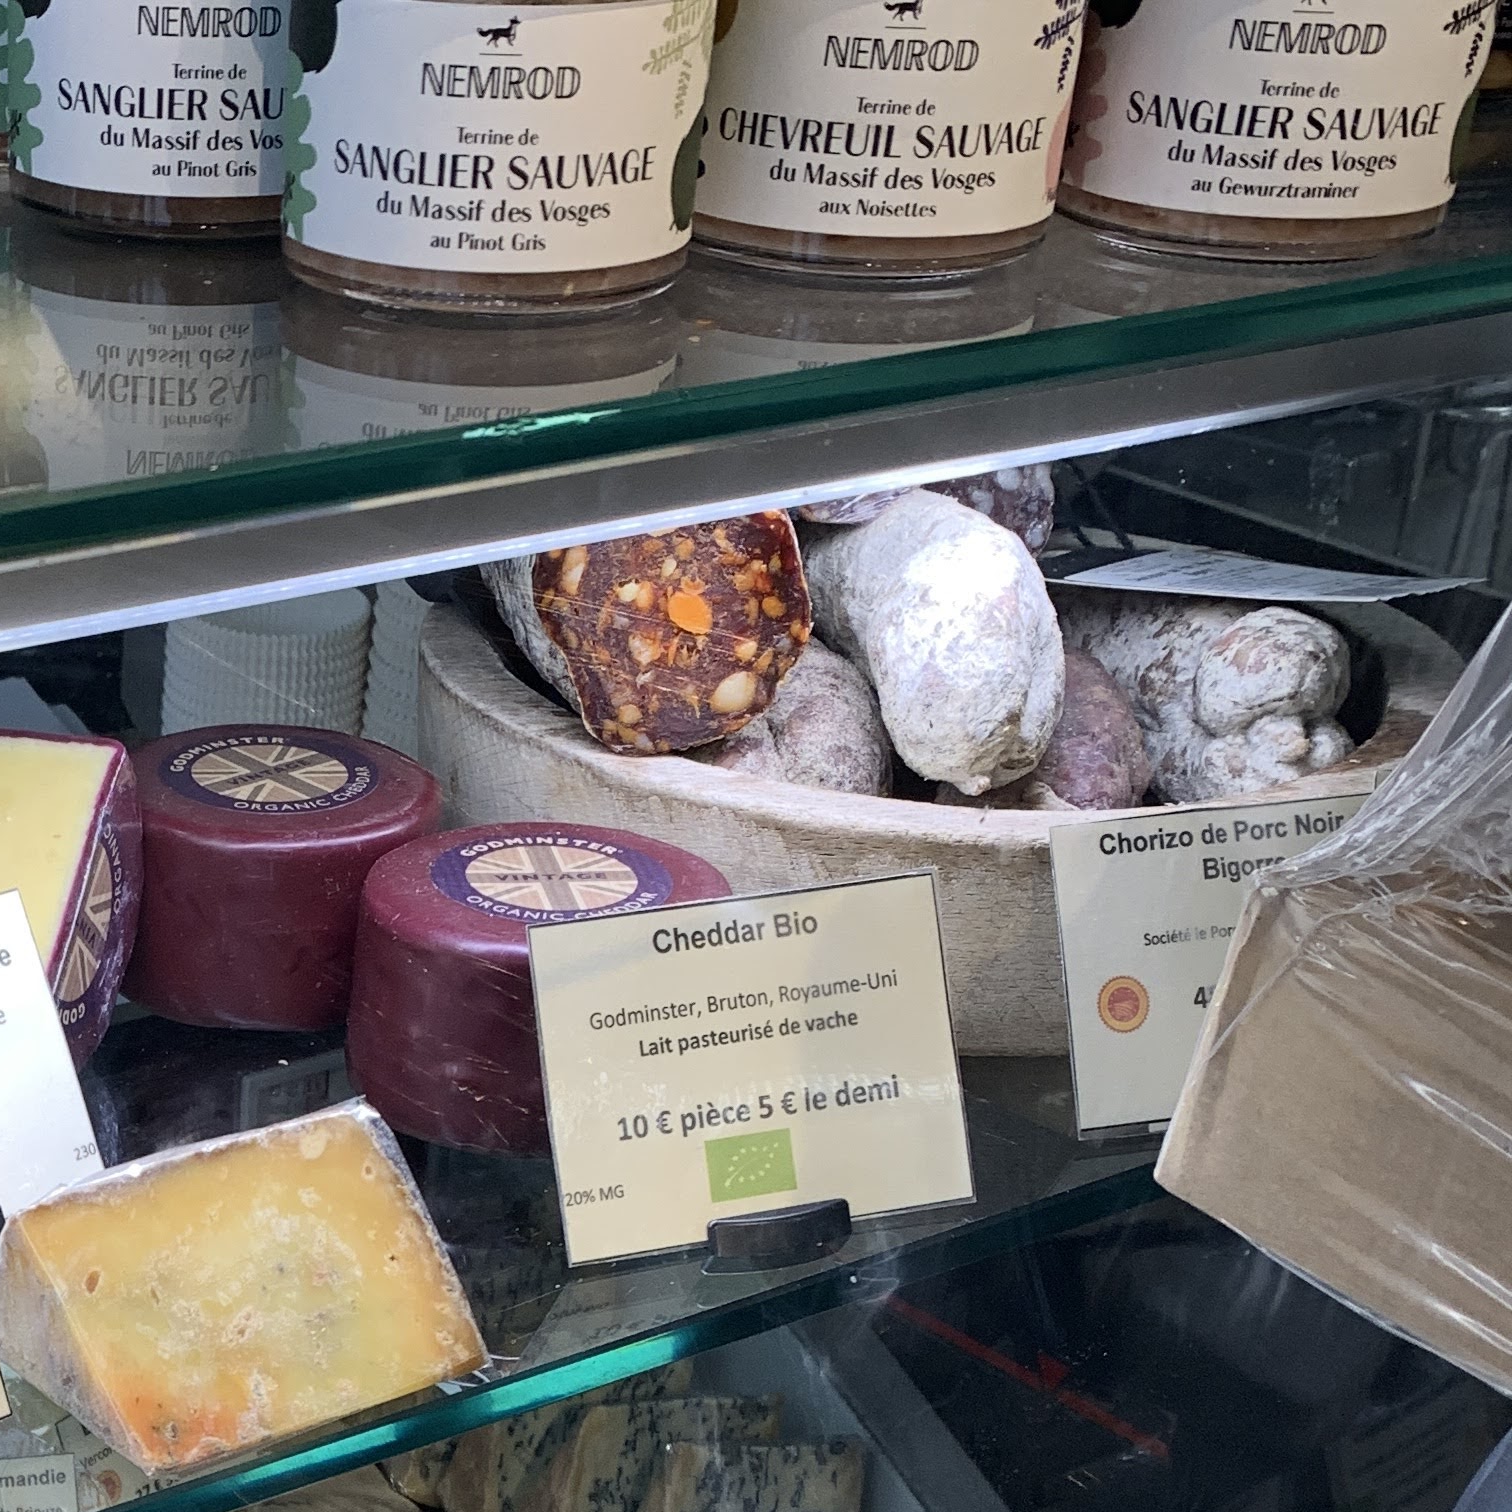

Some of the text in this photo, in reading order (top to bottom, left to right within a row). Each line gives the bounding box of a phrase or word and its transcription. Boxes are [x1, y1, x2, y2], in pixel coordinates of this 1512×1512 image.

[138, 6, 281, 37] NEMROD
[1229, 19, 1387, 54] NEMROD
[823, 35, 980, 71] NEMROD
[420, 62, 581, 100] NEMROD
[719, 107, 1047, 158] CHEVREUIL SAUVAGE
[1126, 90, 1446, 140] SANGLIER SAUVAGE
[457, 127, 540, 145] Terrine de
[334, 139, 657, 190] SANGLIER SAUVAGE
[1191, 177, 1360, 199] au Gewurztraminer
[376, 191, 610, 226] du Massif des Vosges
[819, 199, 937, 218] aux Noisettes
[430, 233, 546, 250] au Pinot Gris
[170, 736, 285, 772] GODMINSTER
[228, 759, 311, 786] VINTAGE
[233, 766, 371, 811] ORGANIC CHEDDAR
[459, 836, 617, 858] GODMINSTER
[1099, 810, 1344, 856] Chorizo de Porc Noir
[495, 872, 608, 882] VINTAGE
[652, 910, 818, 954] Cheddar Bio
[589, 968, 899, 1031] Godminster, Bruton, Royaume-Uni
